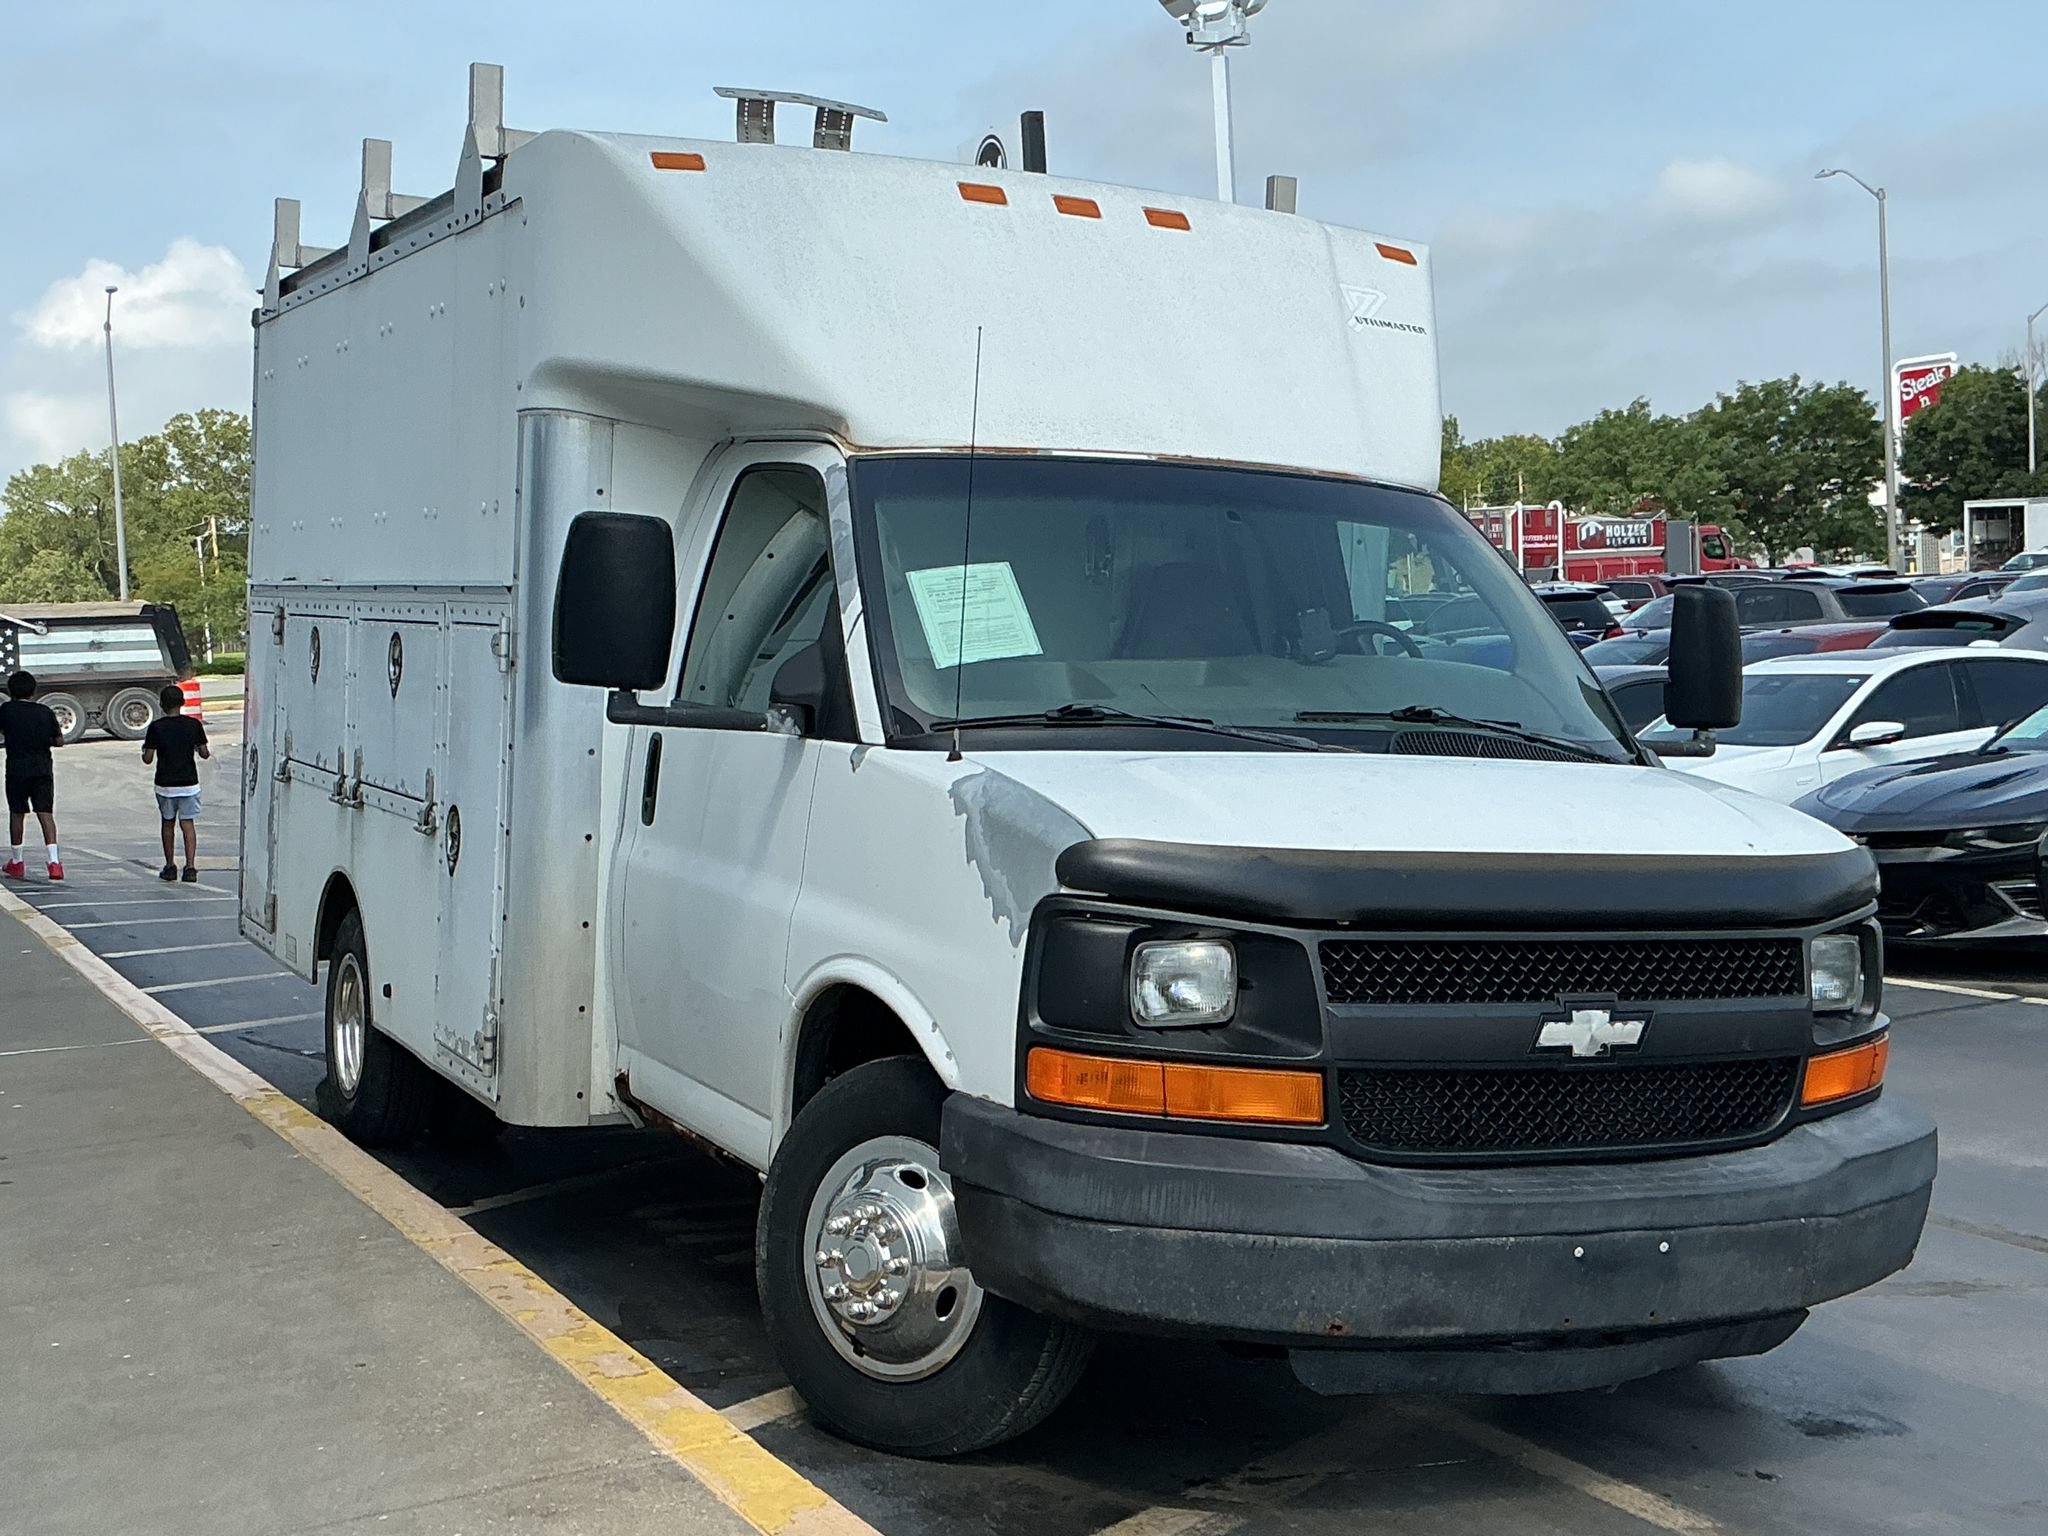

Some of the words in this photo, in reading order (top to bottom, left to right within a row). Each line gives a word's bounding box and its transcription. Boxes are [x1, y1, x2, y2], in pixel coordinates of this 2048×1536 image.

[1355, 316, 1427, 335] UTILIMASTER
[1900, 368, 1947, 401] Steak
[1606, 524, 1647, 537] HOLZER
